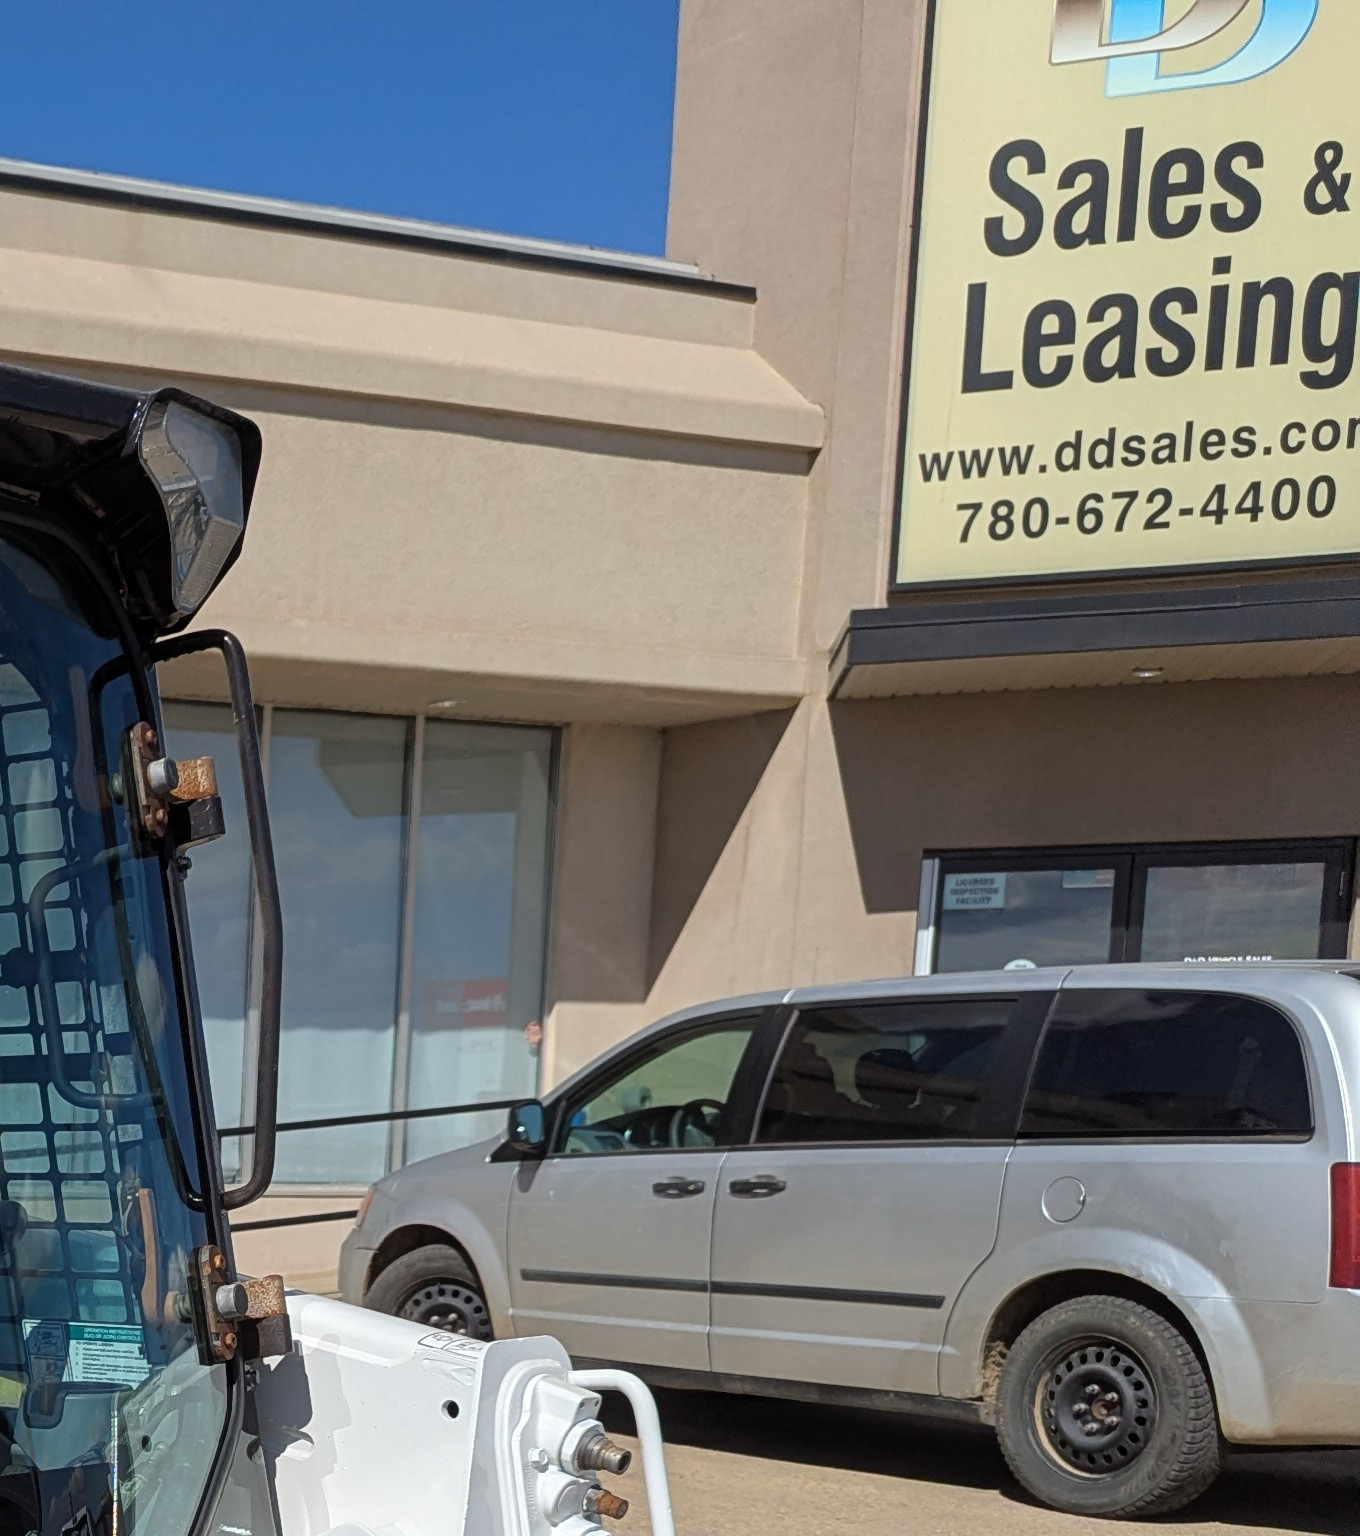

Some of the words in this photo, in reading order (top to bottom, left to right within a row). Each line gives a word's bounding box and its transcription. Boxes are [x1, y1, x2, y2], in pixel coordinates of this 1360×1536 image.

[983, 126, 1265, 258] Sales
[1303, 140, 1352, 216] &
[961, 255, 1360, 394] Leasing
[956, 474, 1337, 544] 780-672-4400
